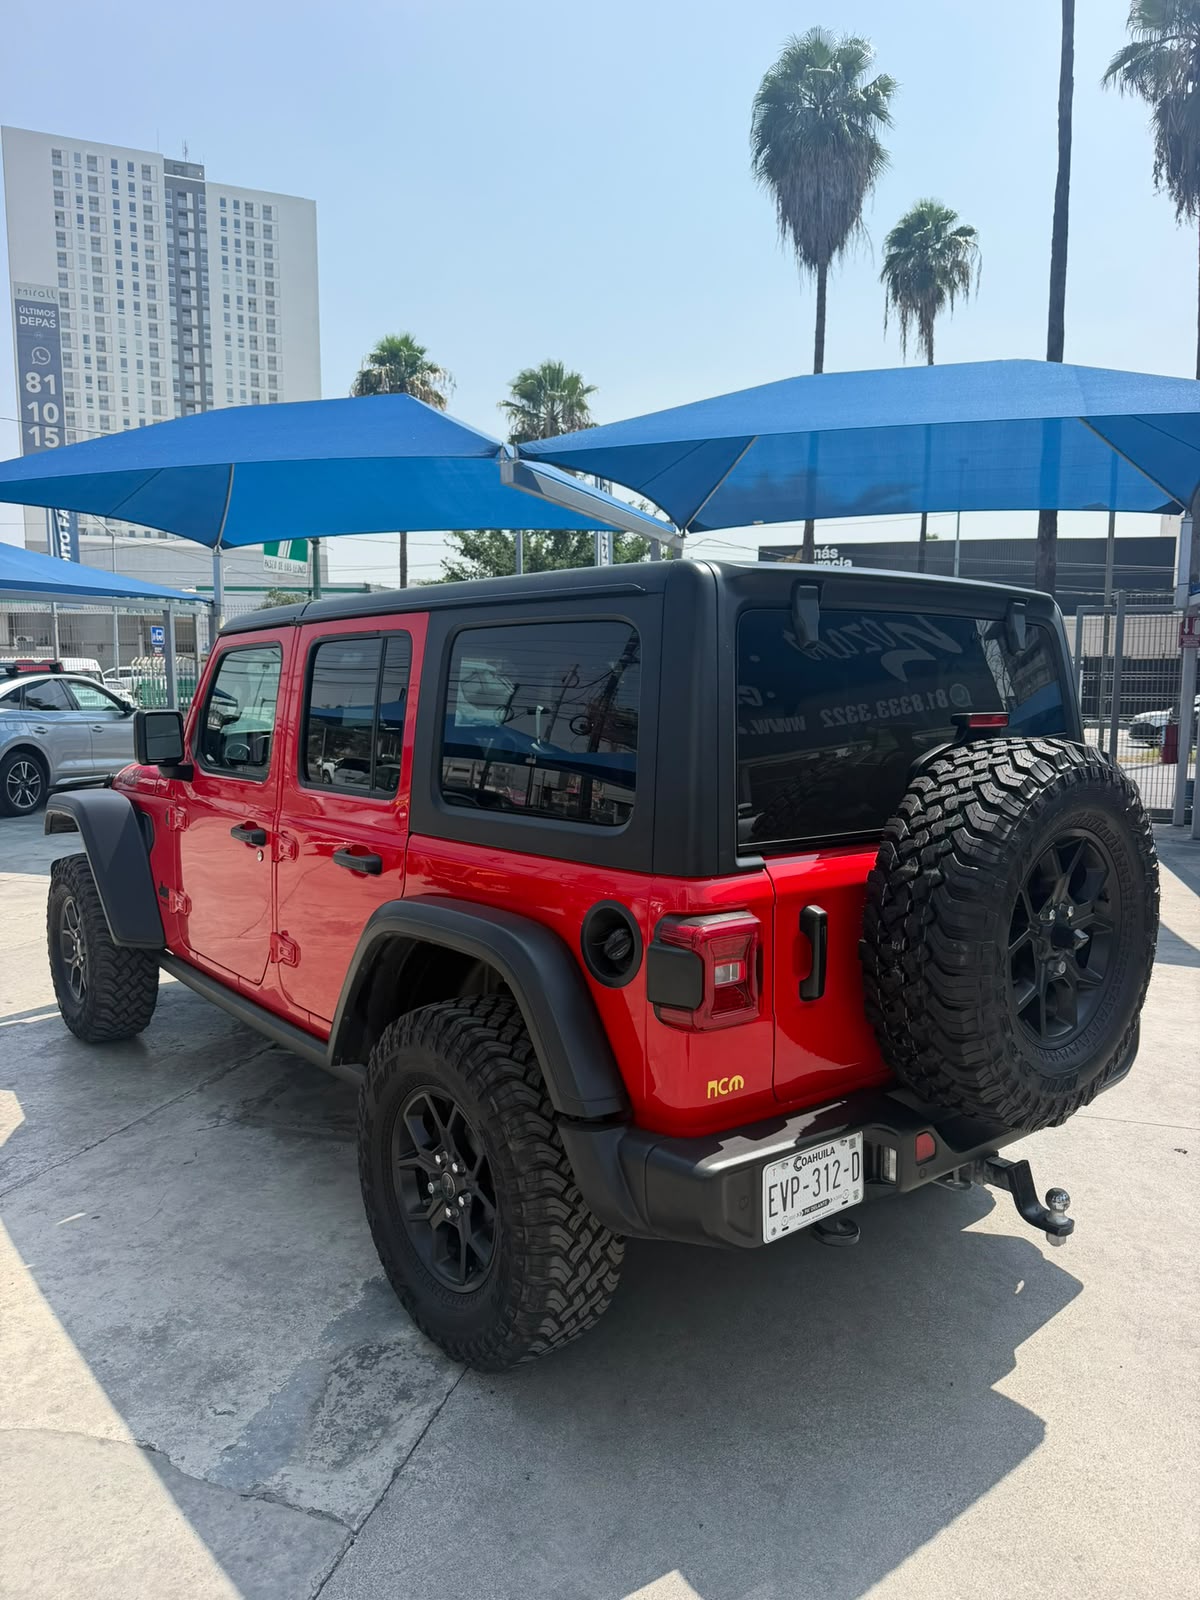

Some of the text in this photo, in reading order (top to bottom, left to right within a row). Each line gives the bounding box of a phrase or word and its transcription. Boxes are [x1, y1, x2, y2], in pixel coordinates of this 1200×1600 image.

[18, 304, 56, 318] ÚLTIMOS
[19, 315, 57, 329] DEPAS
[25, 371, 56, 395] 81
[27, 401, 59, 424] 10
[28, 426, 60, 448] 15
[60, 531, 72, 562] ITO
[793, 1146, 836, 1172] COAHUILA
[768, 1151, 861, 1218] EVP-312-D
